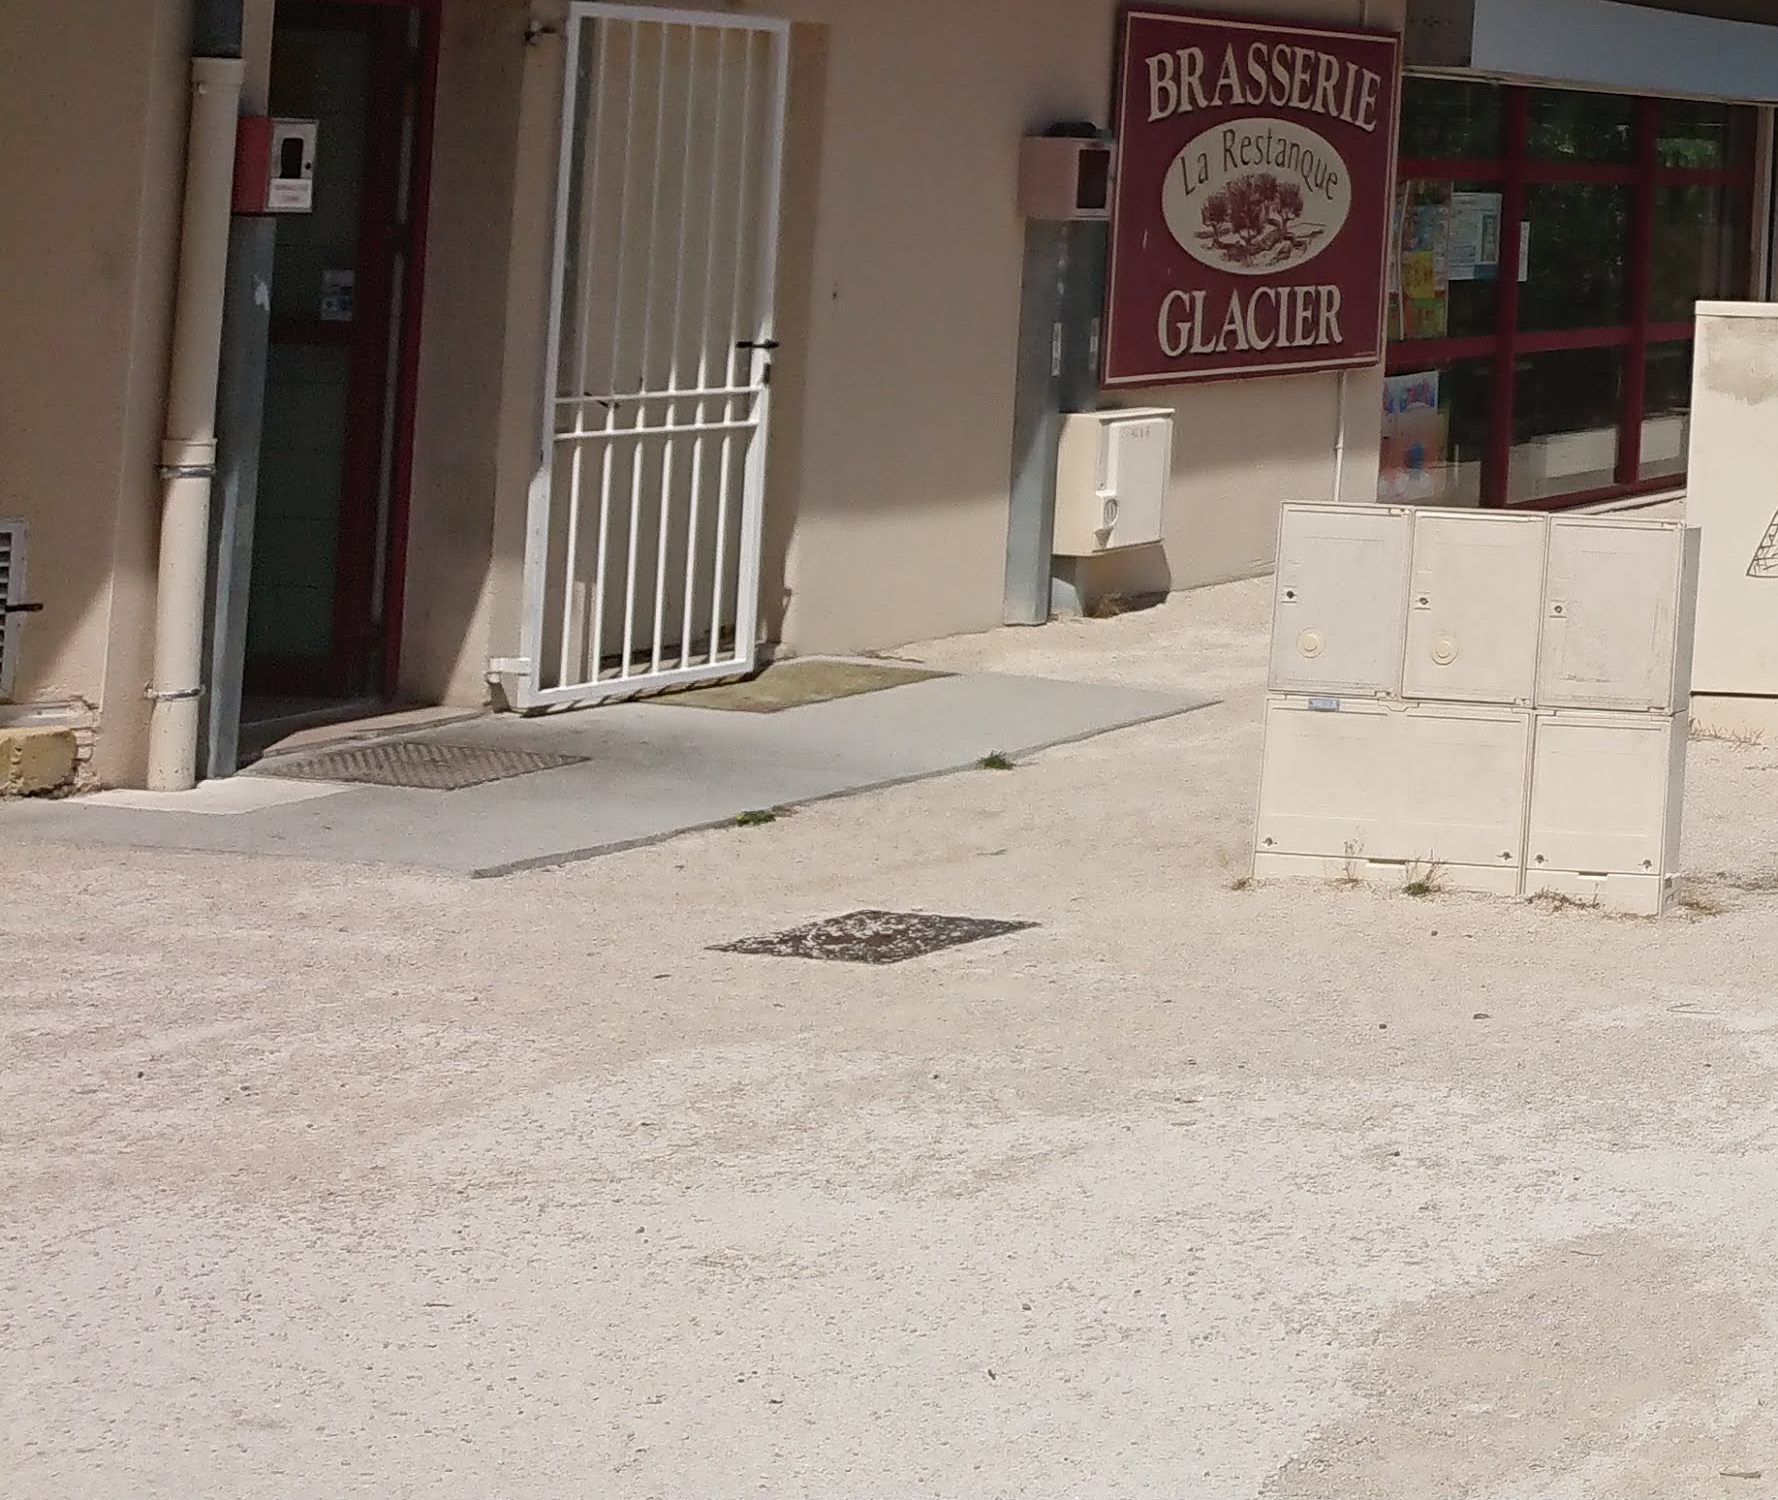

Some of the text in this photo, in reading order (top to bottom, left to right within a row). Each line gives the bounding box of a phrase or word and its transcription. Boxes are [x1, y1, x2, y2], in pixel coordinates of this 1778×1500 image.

[1145, 42, 1381, 132] BRASSERIE
[1180, 152, 1209, 196] La
[1158, 285, 1343, 357] GLACIER
